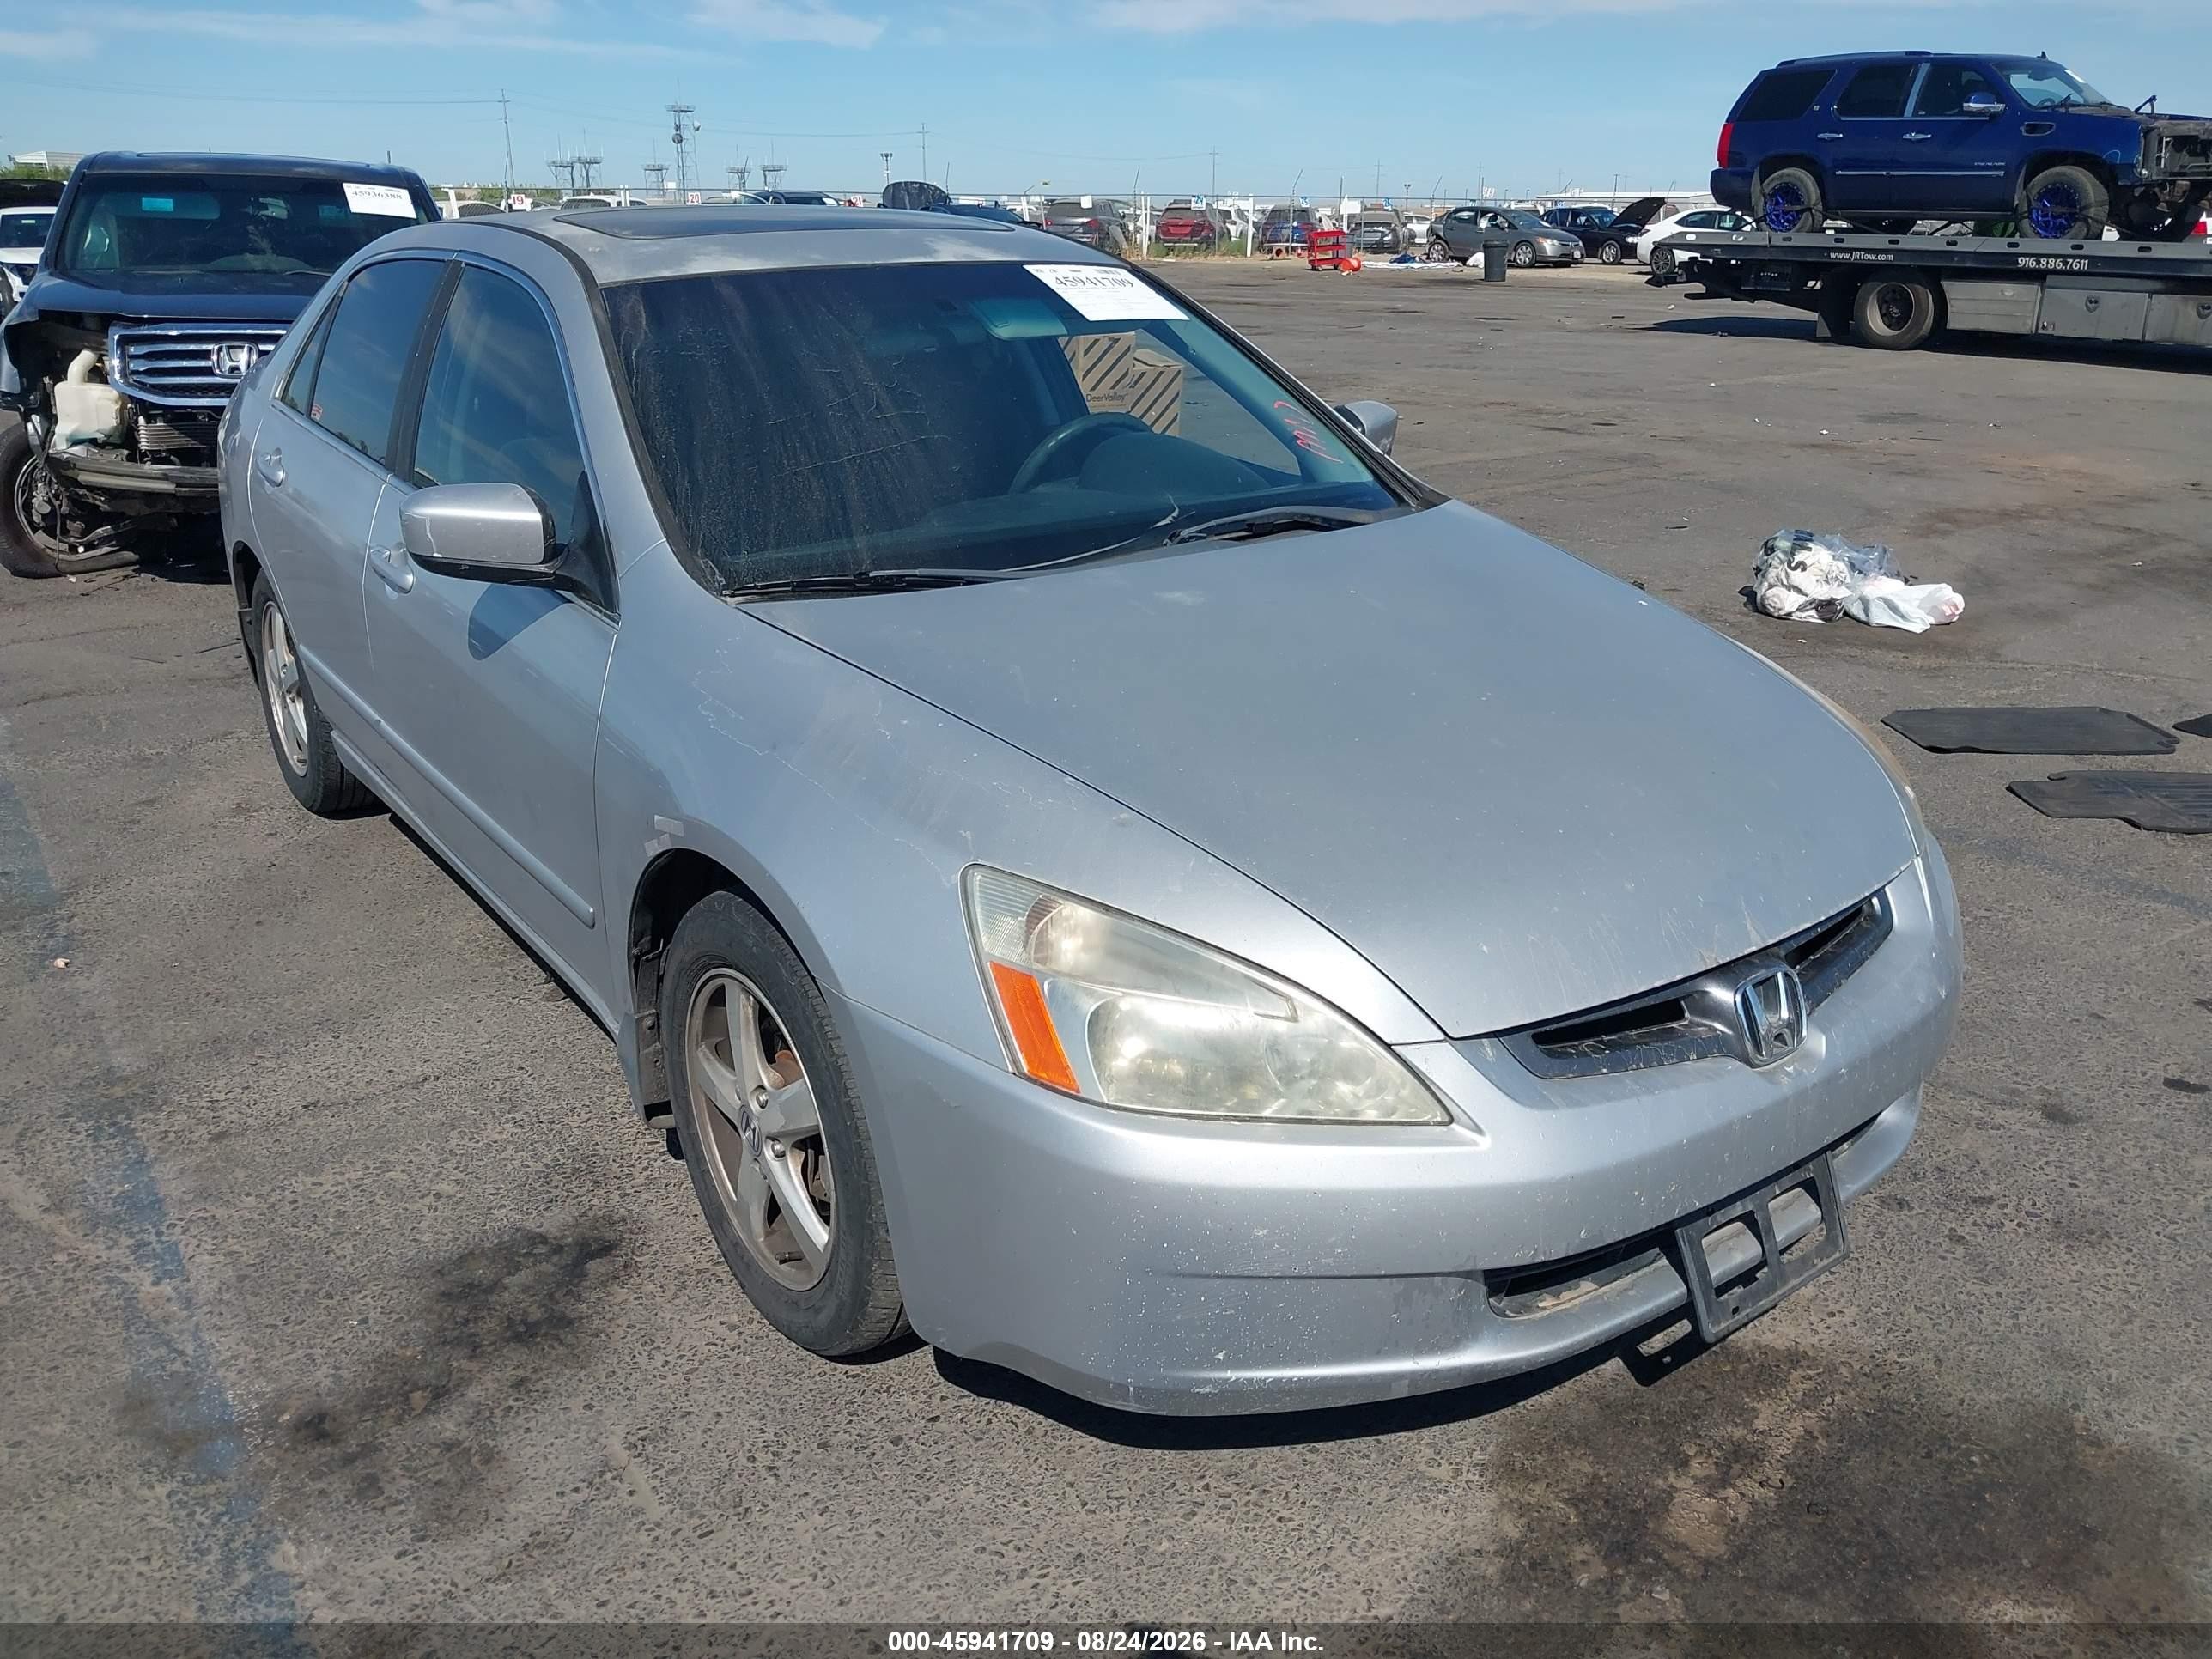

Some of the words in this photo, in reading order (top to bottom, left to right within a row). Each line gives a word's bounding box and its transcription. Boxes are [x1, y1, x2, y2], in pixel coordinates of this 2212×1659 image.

[513, 195, 525, 205] 19
[690, 193, 700, 204] 20
[1830, 251, 1894, 261] www.JRTow.com
[2017, 257, 2089, 270] 916.886.7611
[1054, 276, 1134, 289] 45941709
